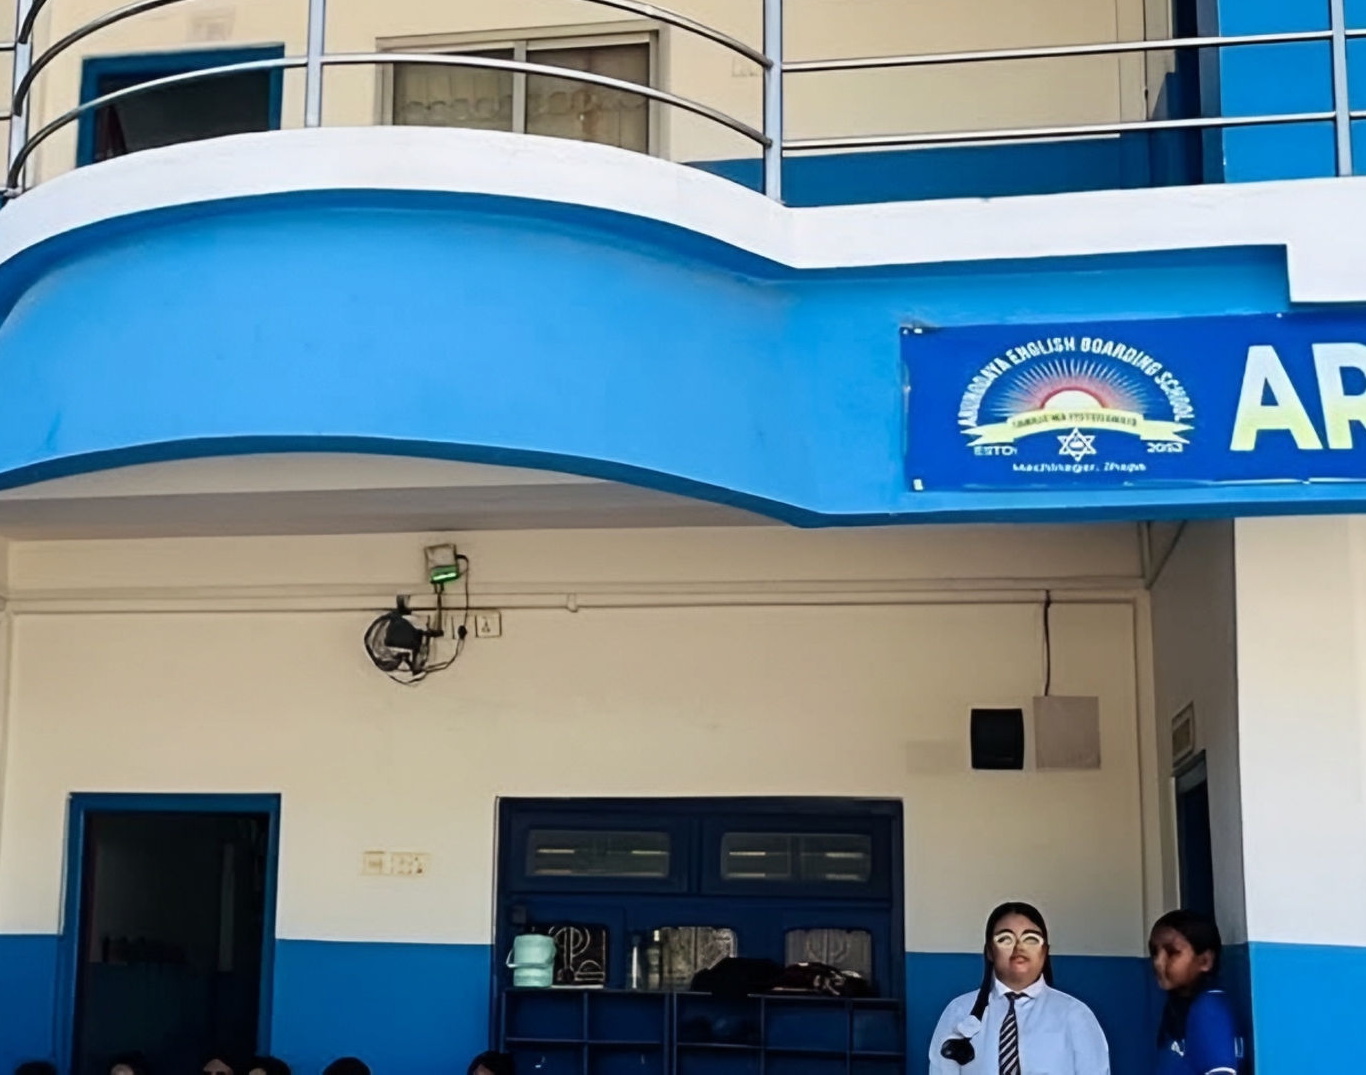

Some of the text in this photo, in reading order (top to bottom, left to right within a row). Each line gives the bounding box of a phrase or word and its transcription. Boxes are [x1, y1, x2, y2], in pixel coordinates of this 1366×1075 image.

[1005, 336, 1076, 365] ENGLISH
[1080, 336, 1163, 376] BOARDING
[1154, 370, 1195, 422] SCHOOL
